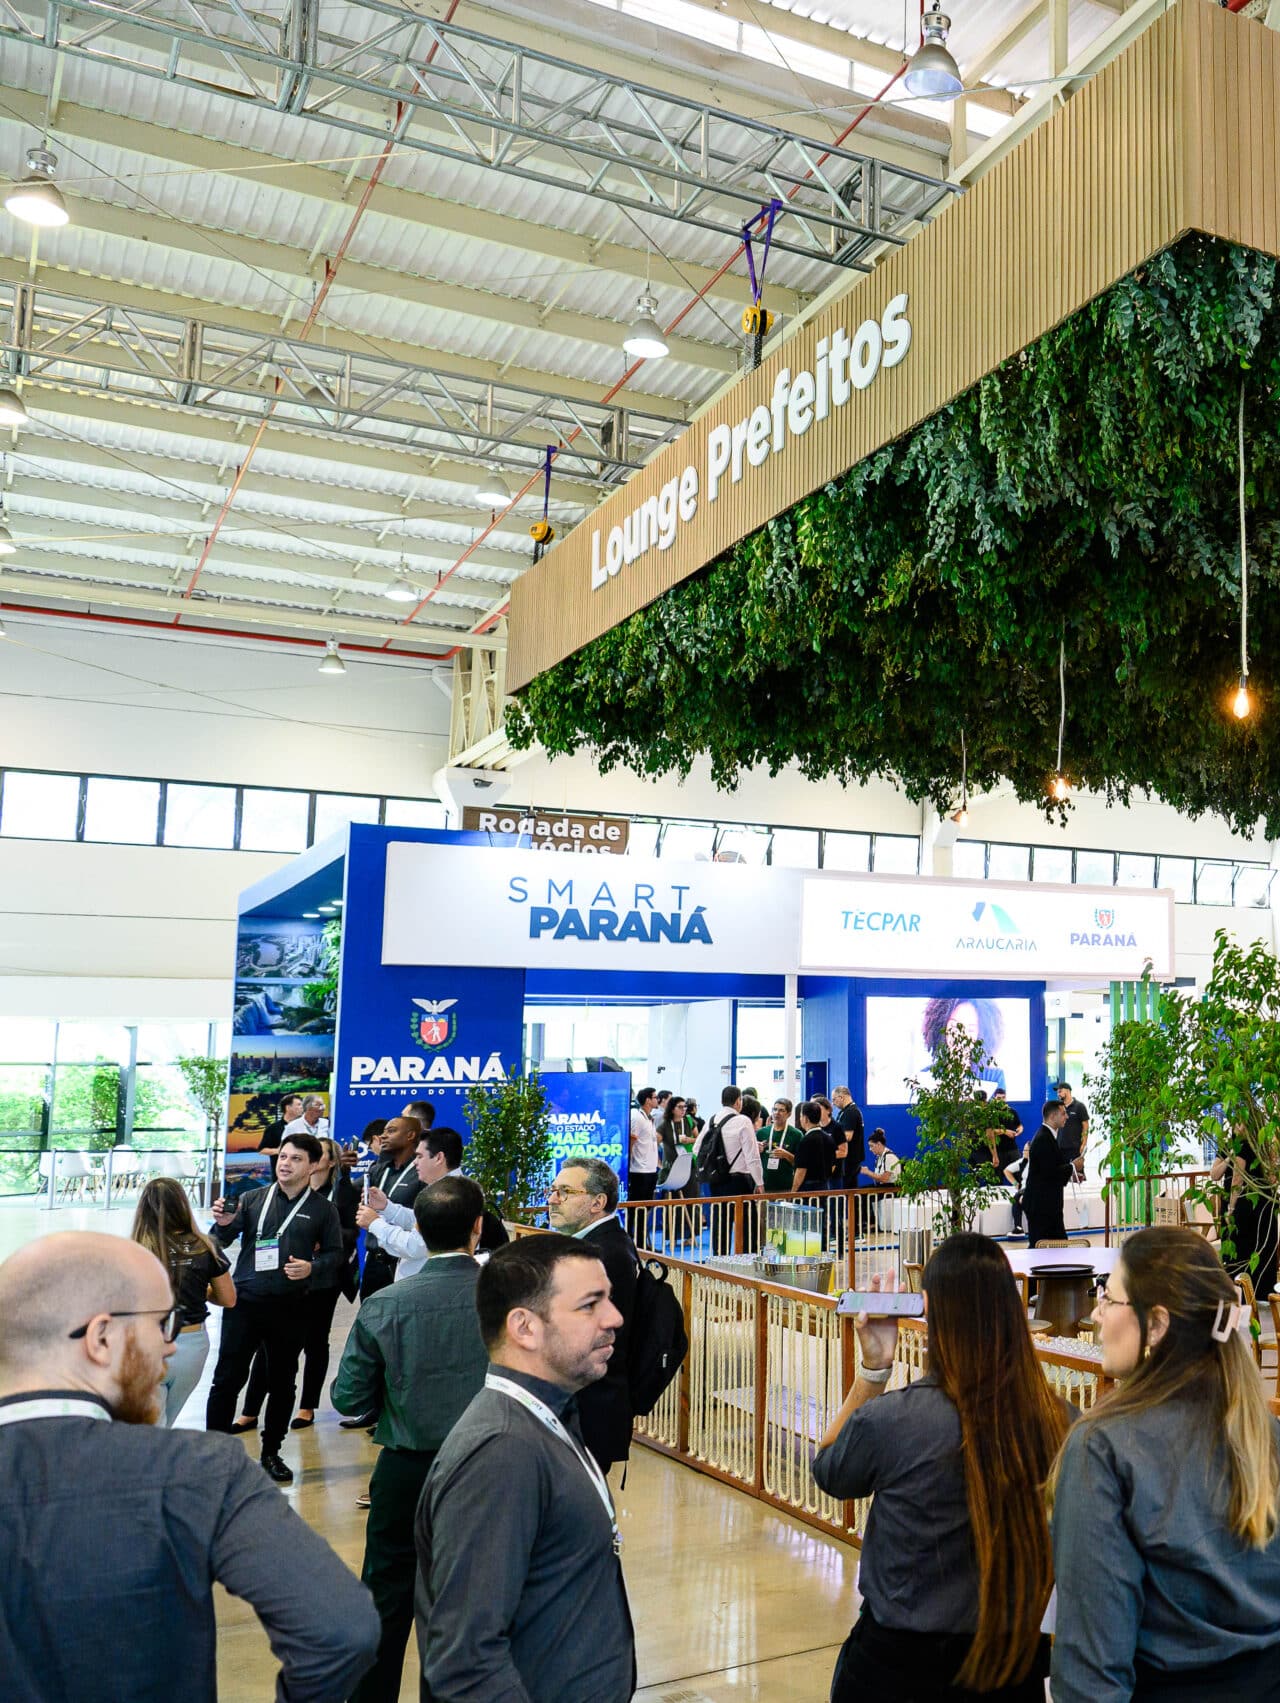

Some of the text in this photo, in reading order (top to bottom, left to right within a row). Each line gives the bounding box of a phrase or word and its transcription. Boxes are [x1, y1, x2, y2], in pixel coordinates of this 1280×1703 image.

[591, 293, 912, 591] Lounge Prefeitos
[478, 812, 621, 841] Rodada de
[508, 876, 690, 910] SMART
[529, 905, 714, 945] PARANÁ
[955, 937, 1038, 951] ARAUCARIA
[1070, 932, 1138, 947] PARANÁ
[350, 1052, 508, 1082] PARANÁ
[349, 1088, 418, 1096] GOVERNO
[428, 1088, 445, 1096] DO
[547, 1131, 590, 1145] MAIS
[564, 1124, 596, 1132] ESTADO
